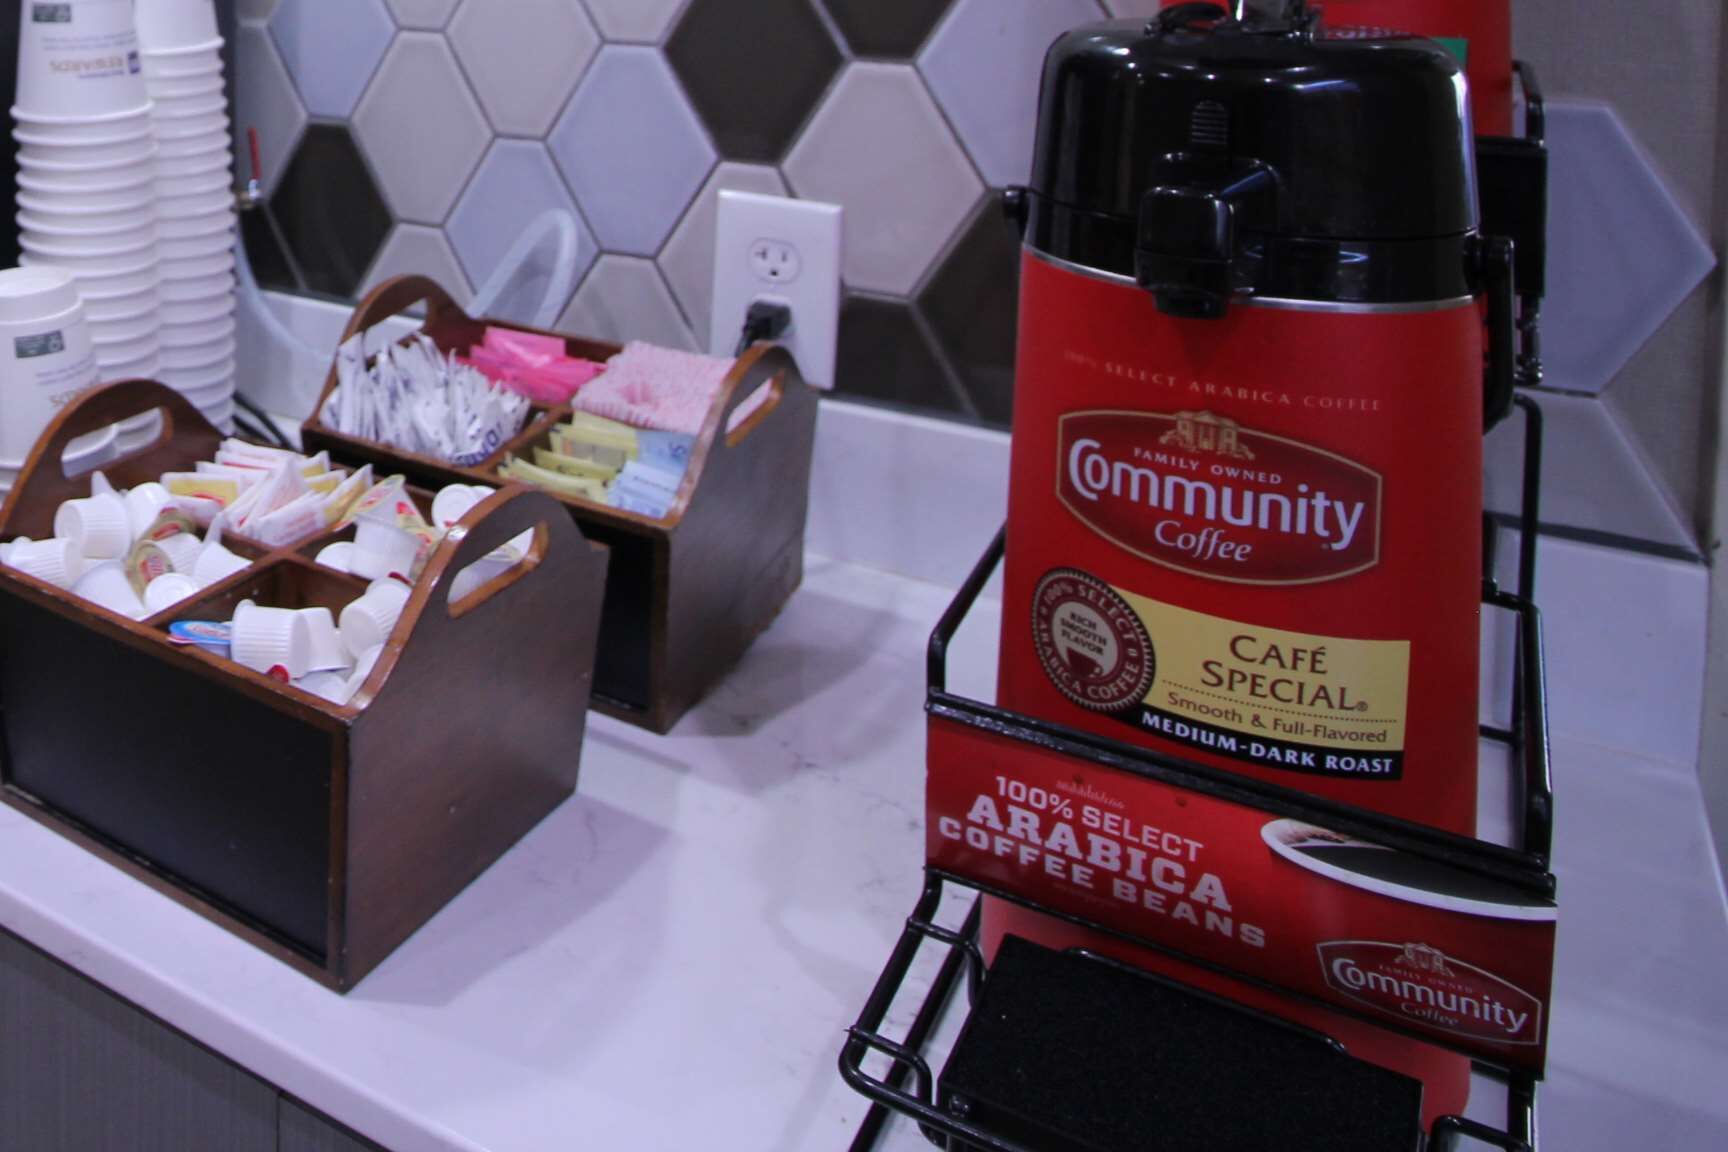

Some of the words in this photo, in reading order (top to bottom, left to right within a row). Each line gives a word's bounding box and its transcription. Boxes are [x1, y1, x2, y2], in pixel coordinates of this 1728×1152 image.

[1104, 361, 1177, 388] SELECT
[1188, 380, 1291, 406] ARABICA
[1303, 395, 1382, 412] COFFEE
[1133, 447, 1200, 472] FAMILY
[1210, 464, 1282, 485] OWNED
[1068, 438, 1364, 551] Community
[1154, 519, 1252, 562] Coffee
[1060, 617, 1108, 647] SMOOTH
[1077, 584, 1138, 642] SELECT
[1060, 628, 1105, 656] FLAVOR
[1228, 634, 1328, 675] CAFÉ
[1086, 661, 1140, 700] COFFEE
[1142, 711, 1316, 768] MEDIUM-DARK
[1325, 755, 1393, 774] ROAST
[1167, 692, 1243, 724] Smooth
[1251, 713, 1266, 729] &
[1273, 718, 1388, 744] Full-Flavored
[995, 775, 1073, 819] 100%
[1081, 805, 1204, 862] SELECT
[967, 794, 1233, 912] ARABICA
[939, 816, 1094, 889] COFFEE
[1112, 877, 1266, 948] BEANS
[1332, 957, 1529, 1033] Community
[1401, 1001, 1460, 1025] Coffee
